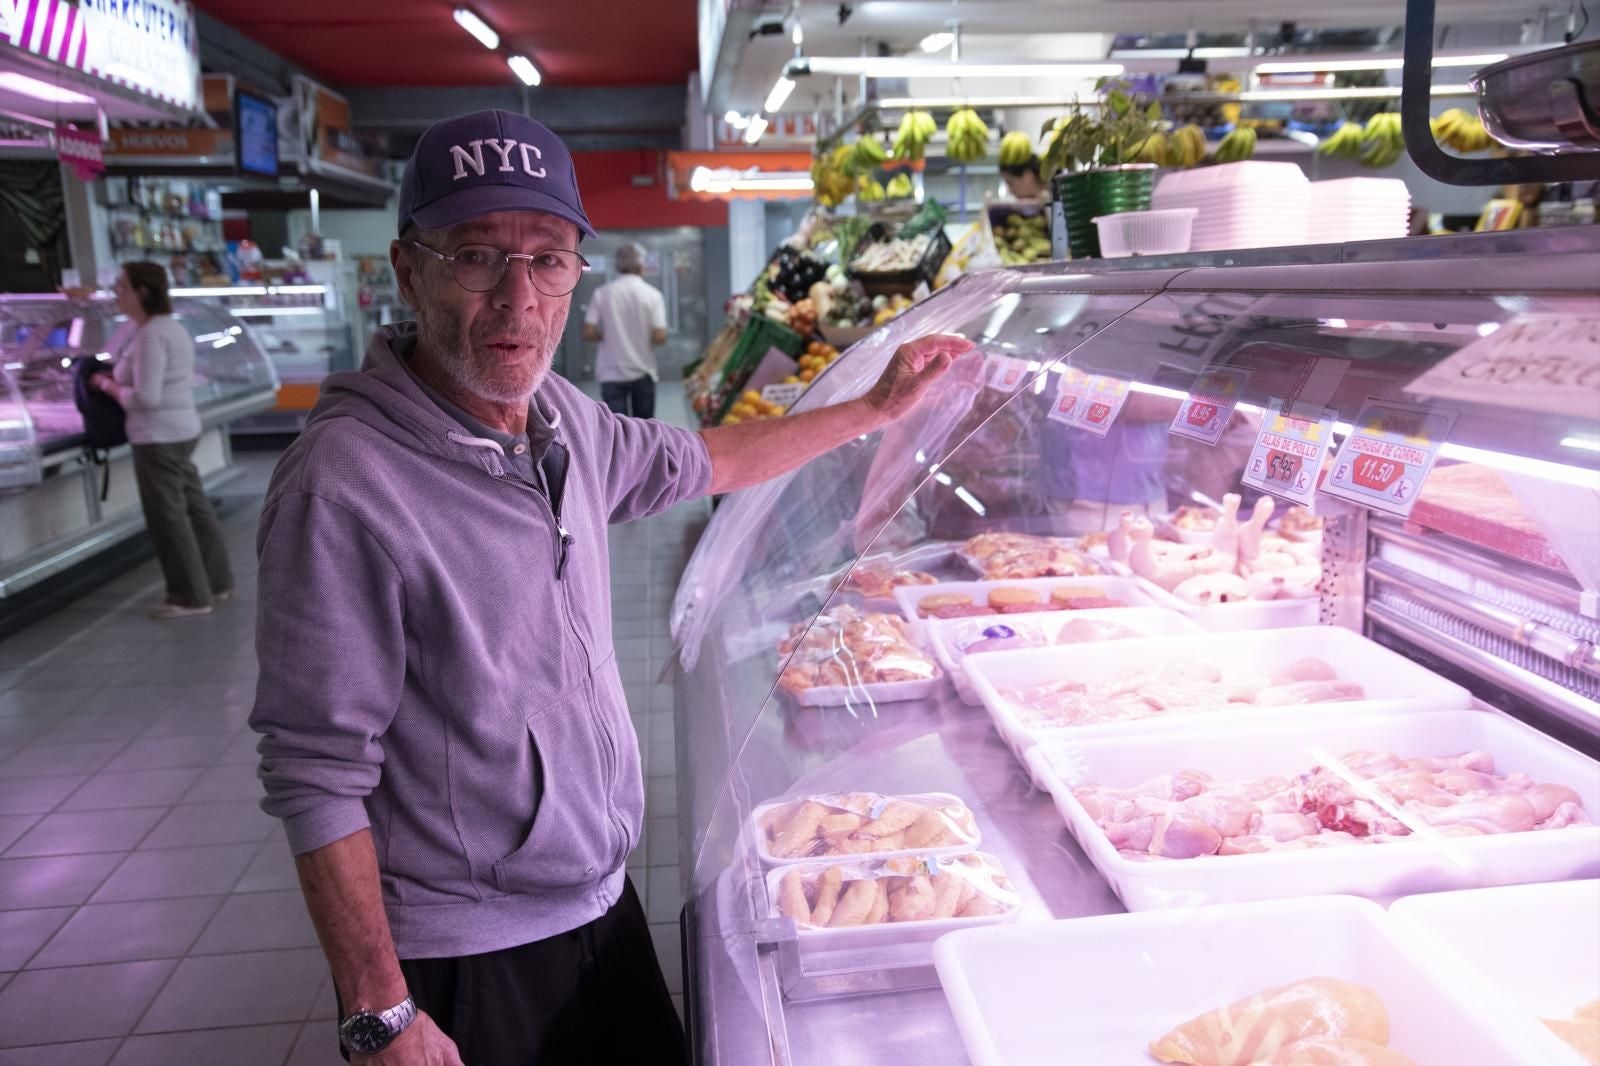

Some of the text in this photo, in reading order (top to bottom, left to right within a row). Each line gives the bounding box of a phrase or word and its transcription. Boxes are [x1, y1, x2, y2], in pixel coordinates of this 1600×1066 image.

[450, 138, 546, 180] NYC
[1262, 436, 1318, 457] ALAS DE POLLO
